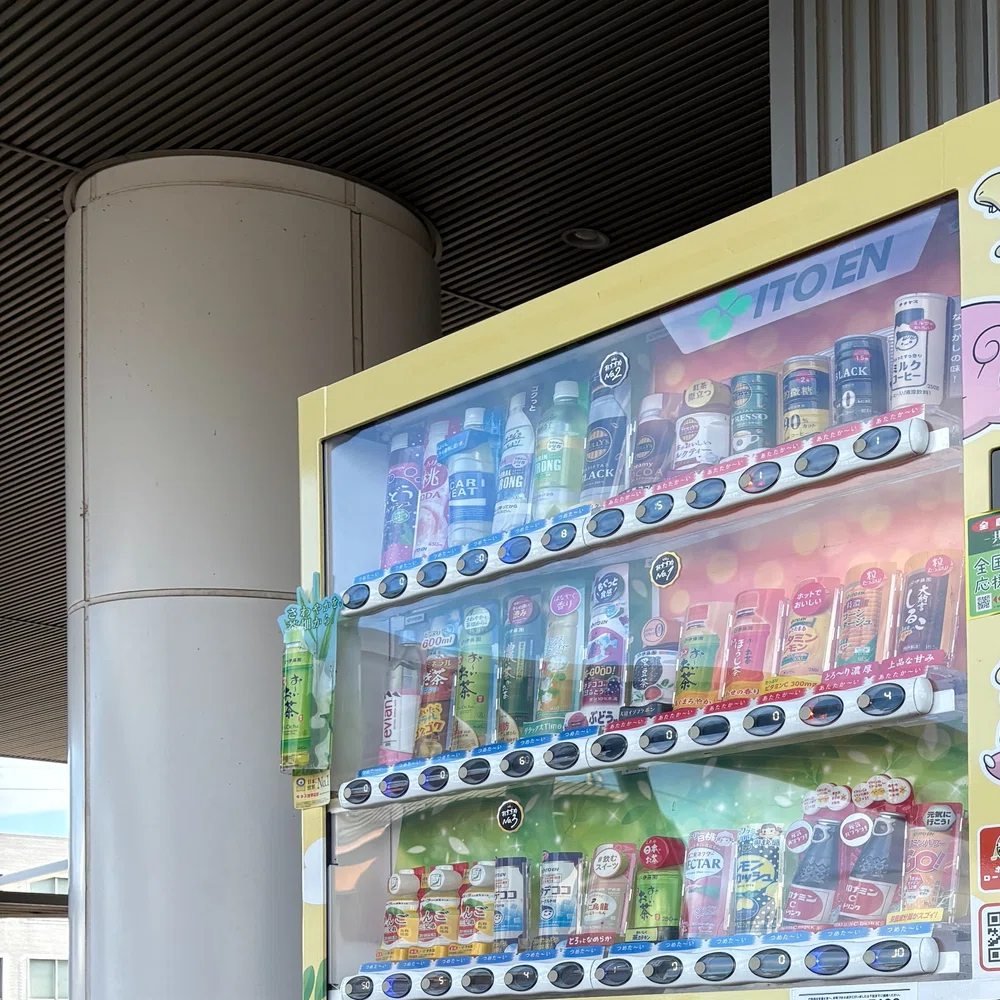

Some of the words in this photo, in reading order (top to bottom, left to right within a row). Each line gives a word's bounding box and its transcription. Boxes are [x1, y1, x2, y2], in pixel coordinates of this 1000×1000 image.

[753, 264, 826, 319] ITO
[832, 235, 894, 289] EN
[693, 382, 707, 392] 紅茶
[797, 590, 822, 600] ホットで
[794, 598, 822, 609] おいしい
[786, 634, 818, 644] タミン
[888, 654, 935, 669] 上品な甘み
[595, 862, 619, 871] スイーツ
[568, 936, 612, 945] とろっとなめらか
